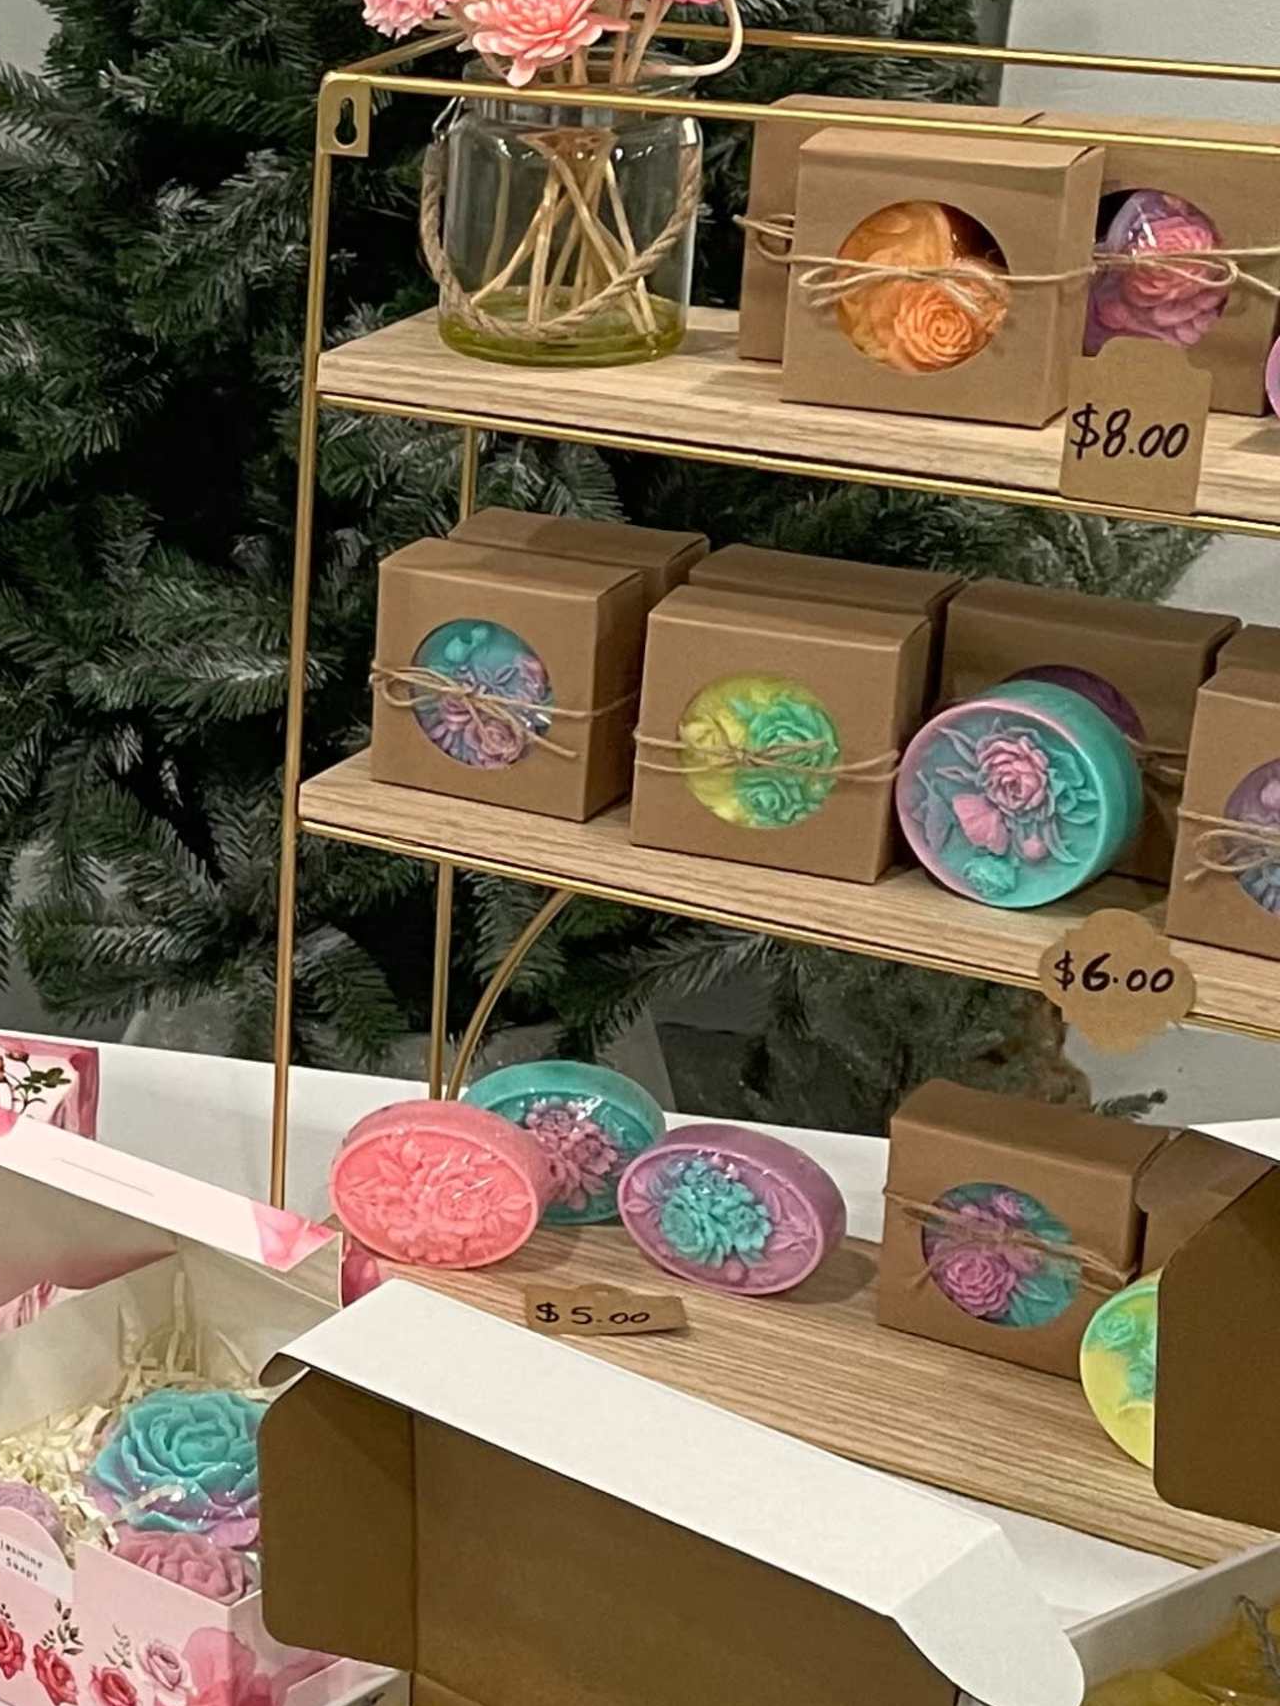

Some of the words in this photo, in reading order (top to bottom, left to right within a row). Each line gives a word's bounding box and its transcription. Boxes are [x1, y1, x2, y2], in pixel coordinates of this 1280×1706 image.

[1069, 402, 1190, 461] $8.00
[1052, 950, 1175, 993] $6.00
[535, 1302, 650, 1325] $5.00
